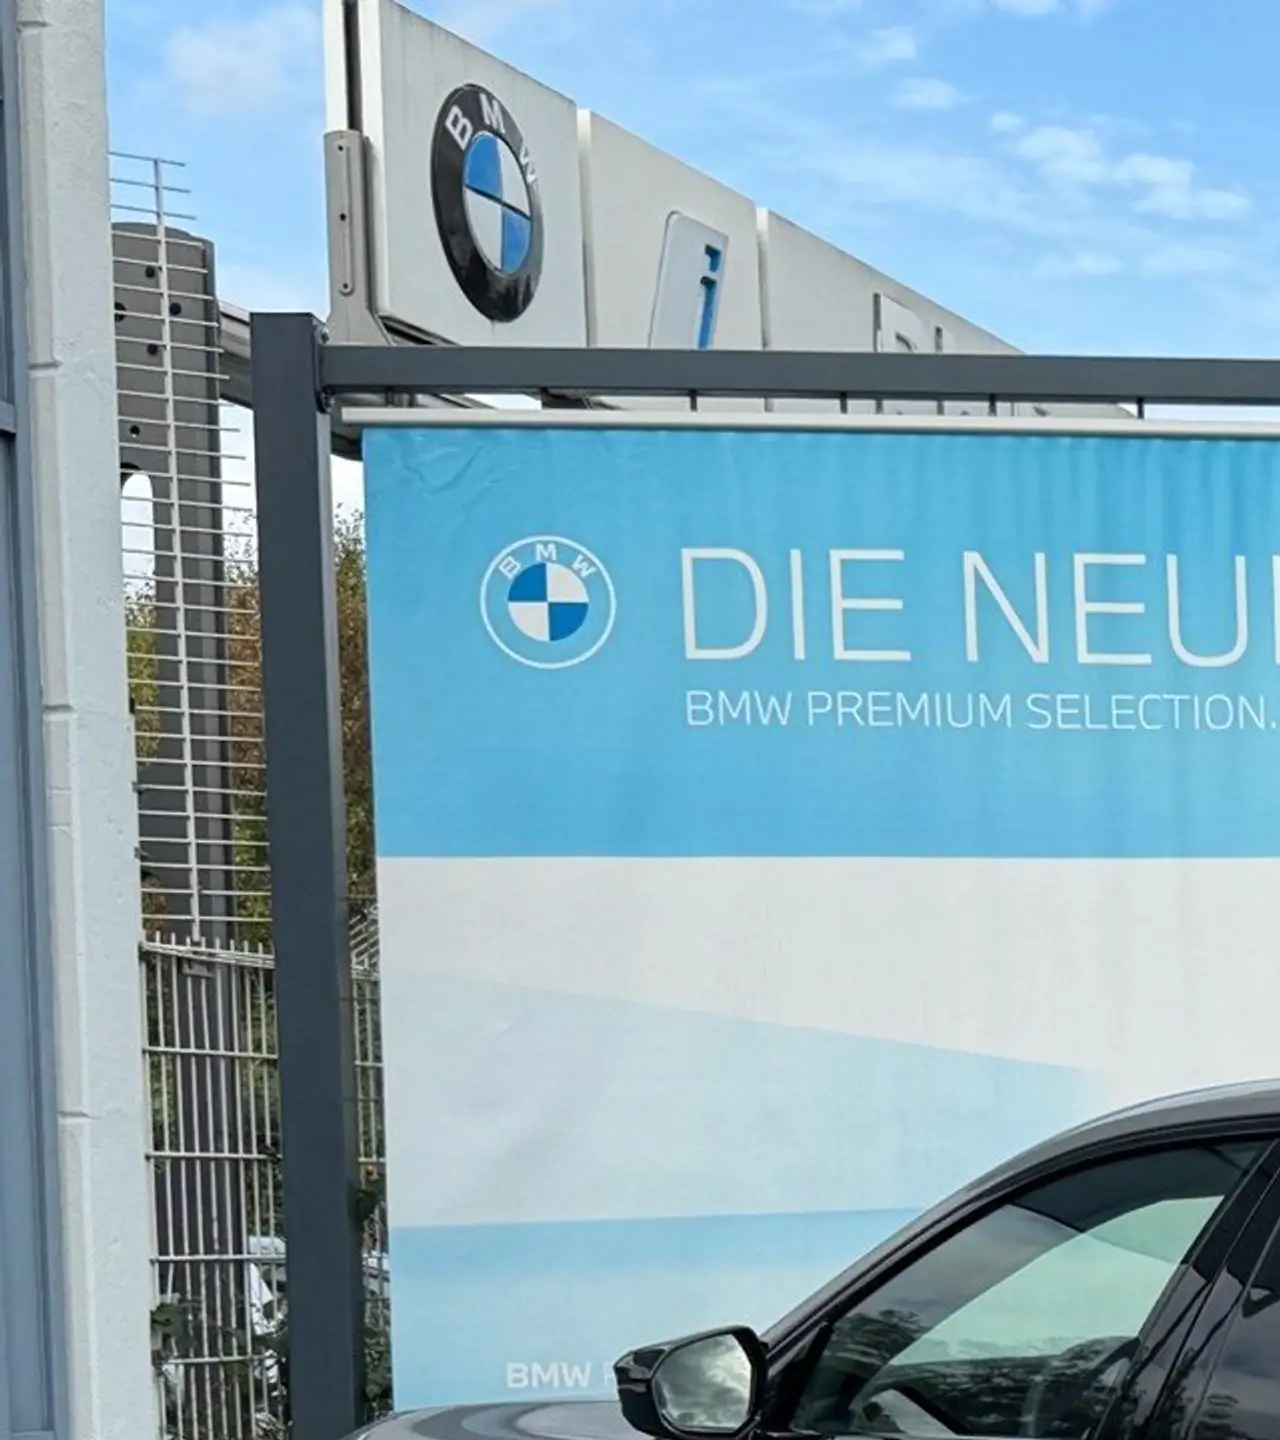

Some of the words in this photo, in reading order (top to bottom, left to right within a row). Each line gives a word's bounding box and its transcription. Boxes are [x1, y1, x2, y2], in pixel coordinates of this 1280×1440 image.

[445, 93, 538, 188] BMW
[498, 542, 597, 580] BMW
[679, 547, 912, 663] DIE
[685, 690, 792, 727] BMW
[807, 690, 1013, 729] PREMIUM
[1027, 692, 1278, 732] SELECTION.
[506, 1361, 593, 1389] BMW
